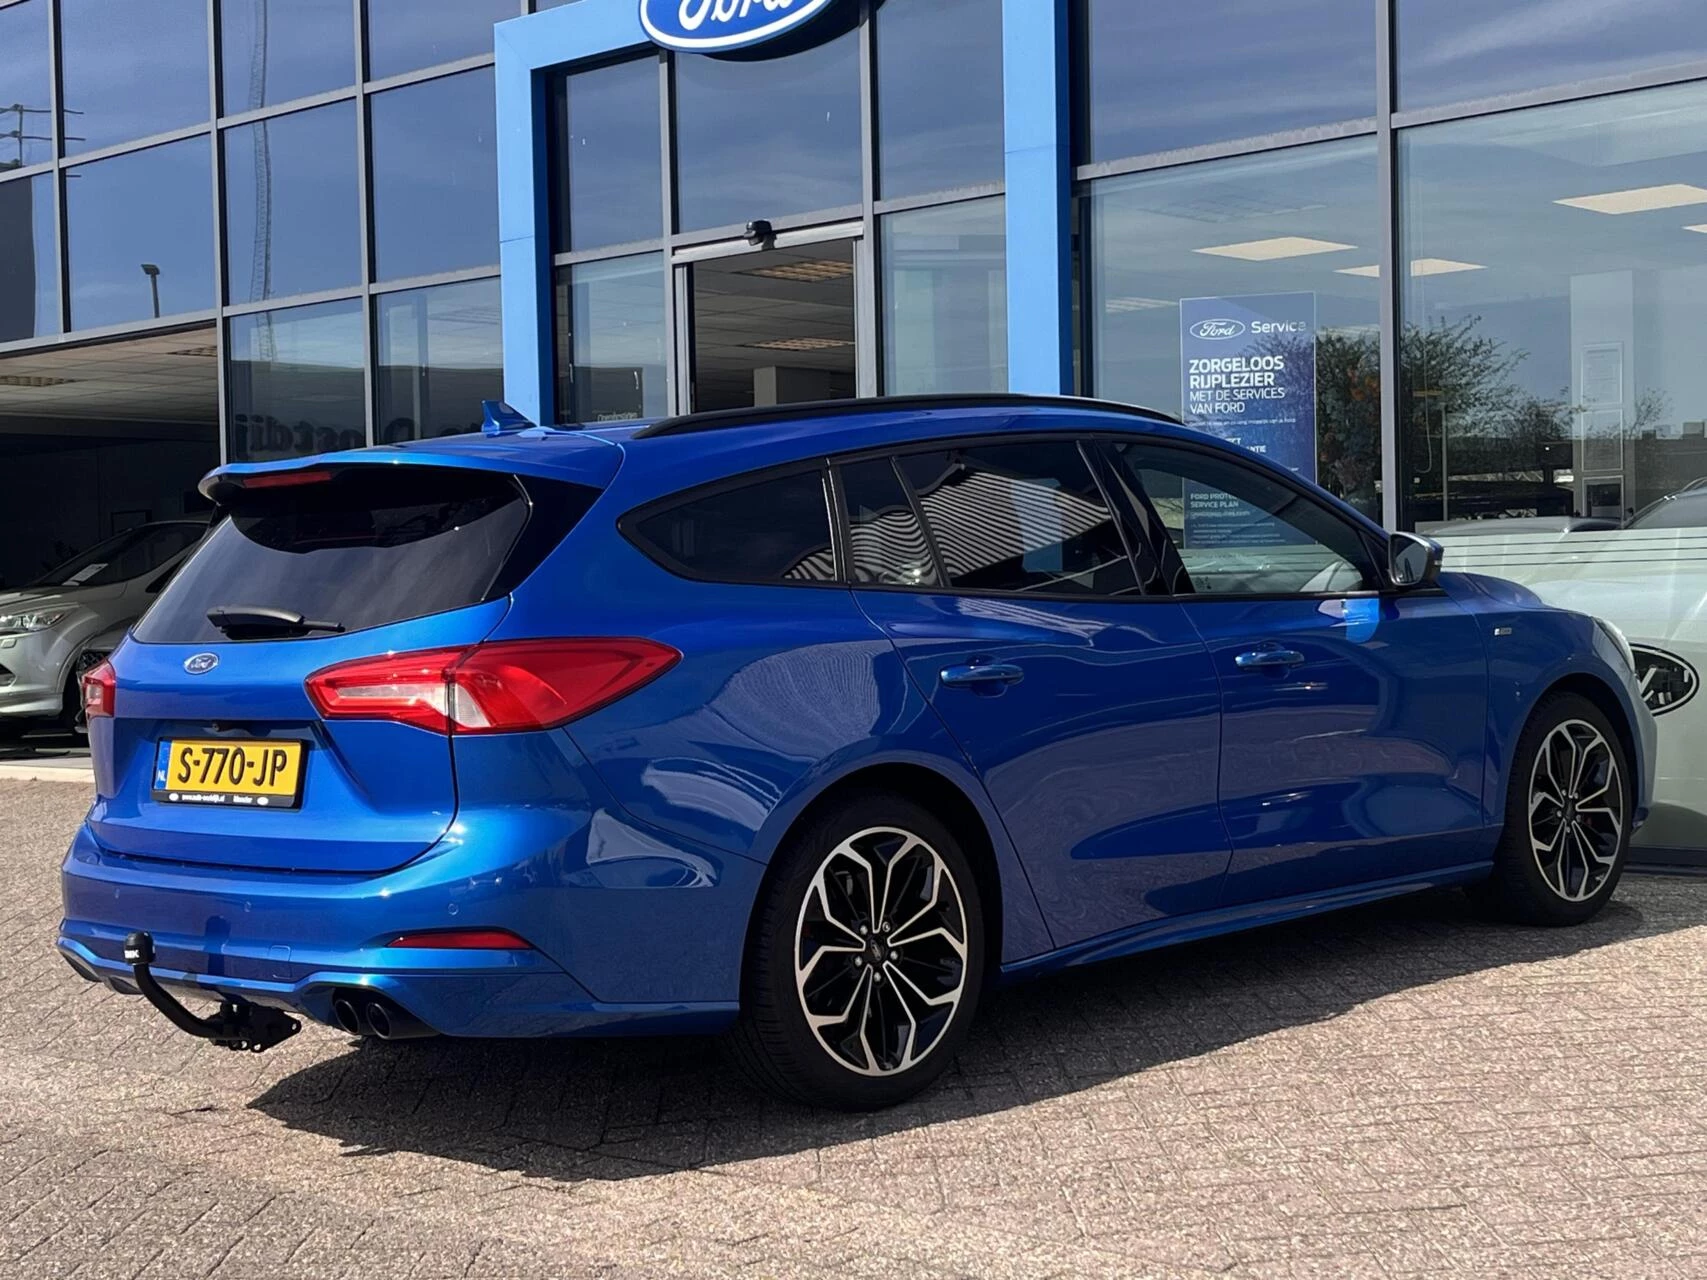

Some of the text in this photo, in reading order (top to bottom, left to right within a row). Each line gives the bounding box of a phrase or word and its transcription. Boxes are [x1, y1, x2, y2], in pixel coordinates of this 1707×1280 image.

[1200, 321, 1306, 337] Ford Service
[1189, 356, 1285, 374] ZORGELOOS
[1190, 372, 1275, 389] RIJPLEZIER
[1190, 387, 1286, 402] MET DE SERVICES
[1190, 401, 1246, 414] VAN FORD
[177, 747, 287, 787] S-770-JP
